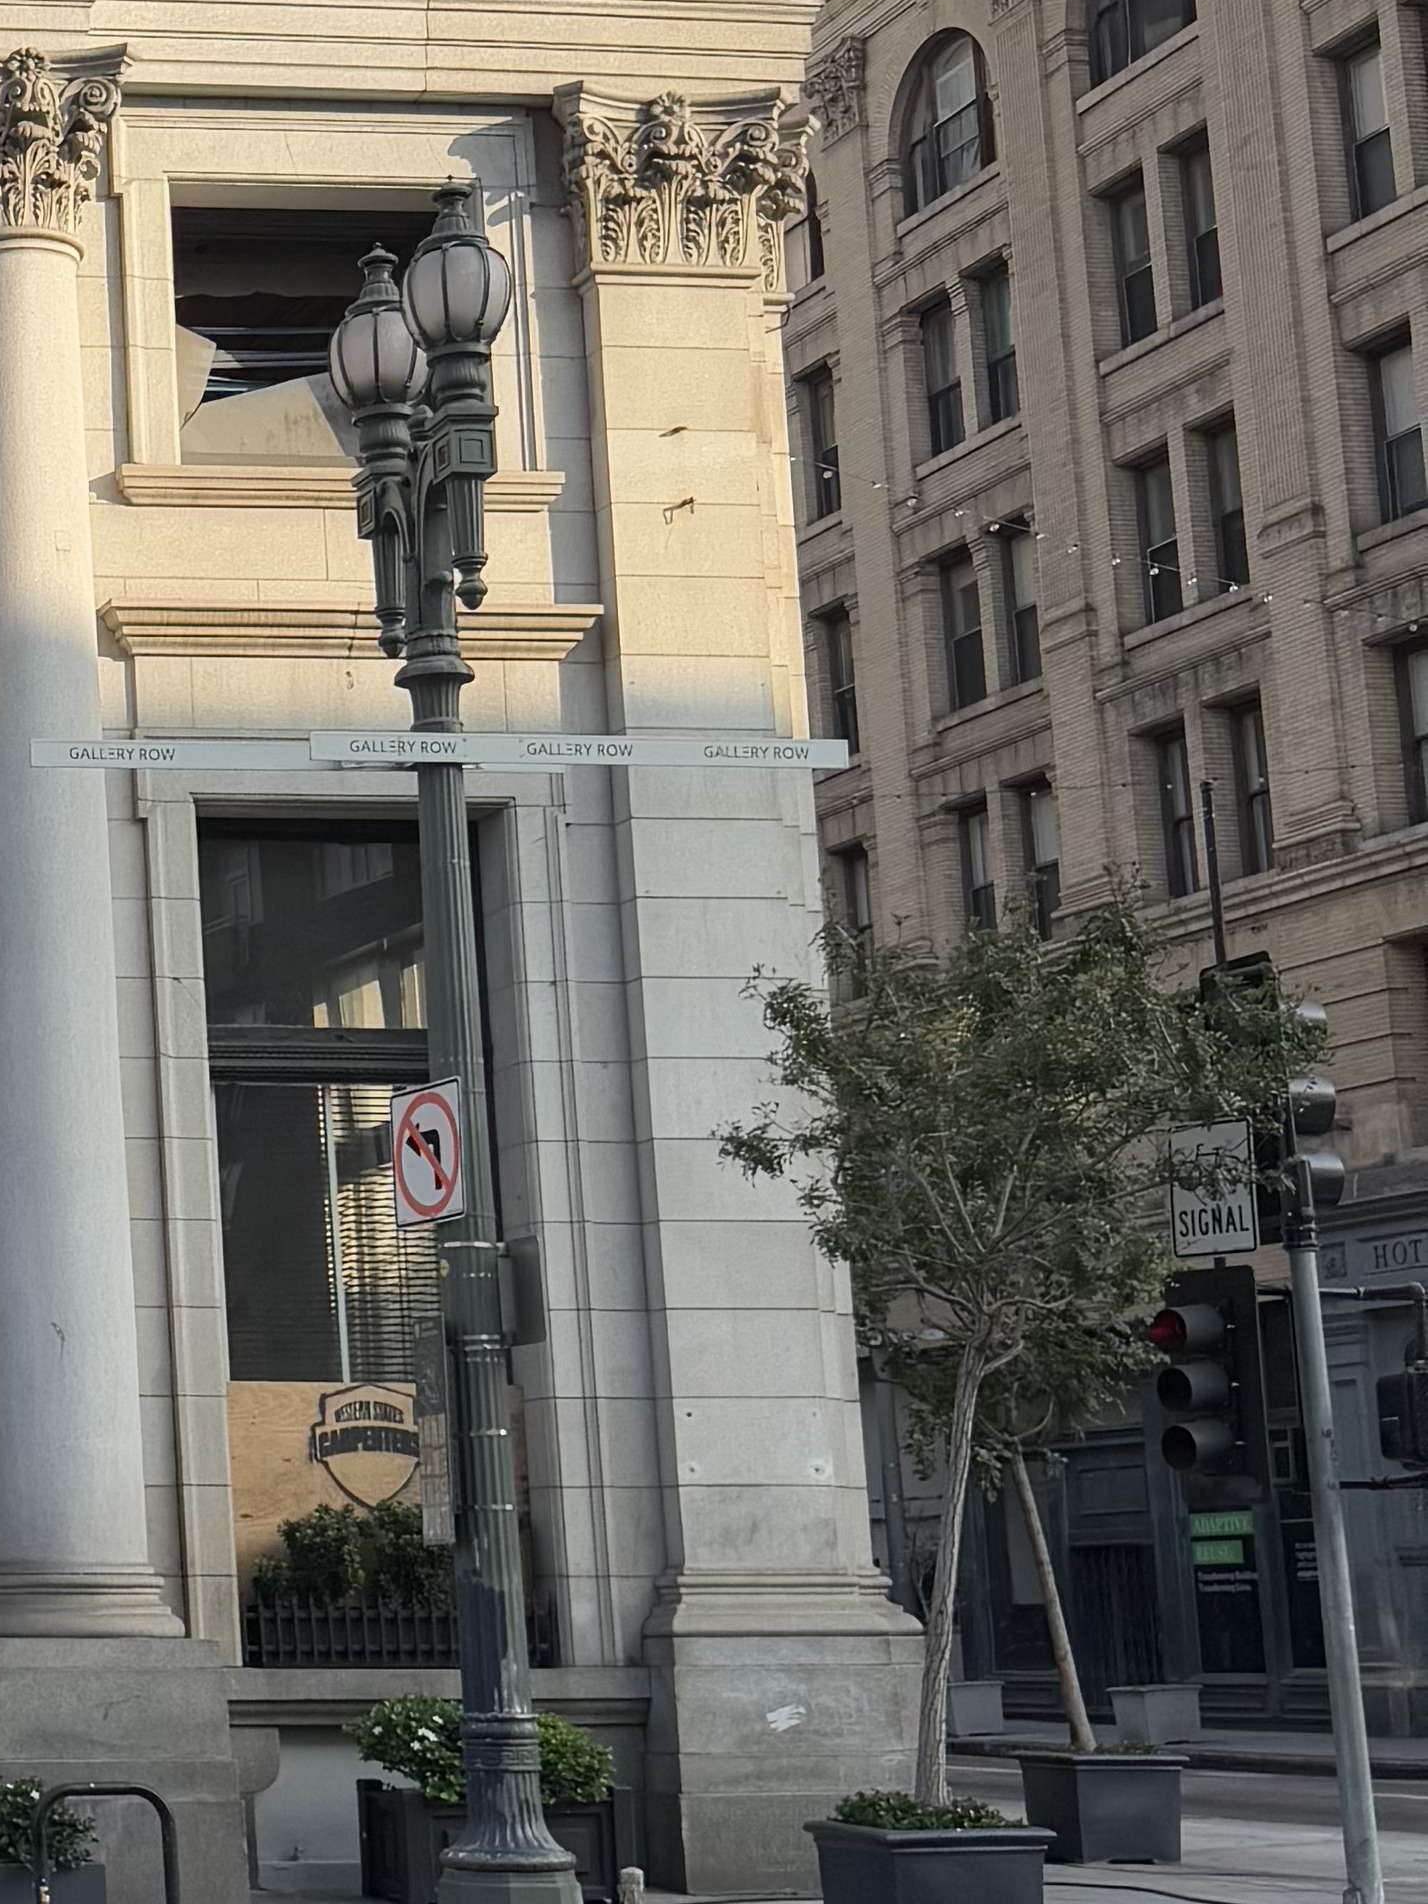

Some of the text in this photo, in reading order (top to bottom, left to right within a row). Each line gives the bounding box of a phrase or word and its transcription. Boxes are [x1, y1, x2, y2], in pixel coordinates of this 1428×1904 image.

[69, 746, 176, 762] GALLERY ROW
[349, 739, 458, 755] GALLERY ROW
[526, 742, 634, 758] GALLERY ROW
[703, 745, 810, 761] GALLERY ROW
[1179, 1204, 1250, 1238] SIGNAL
